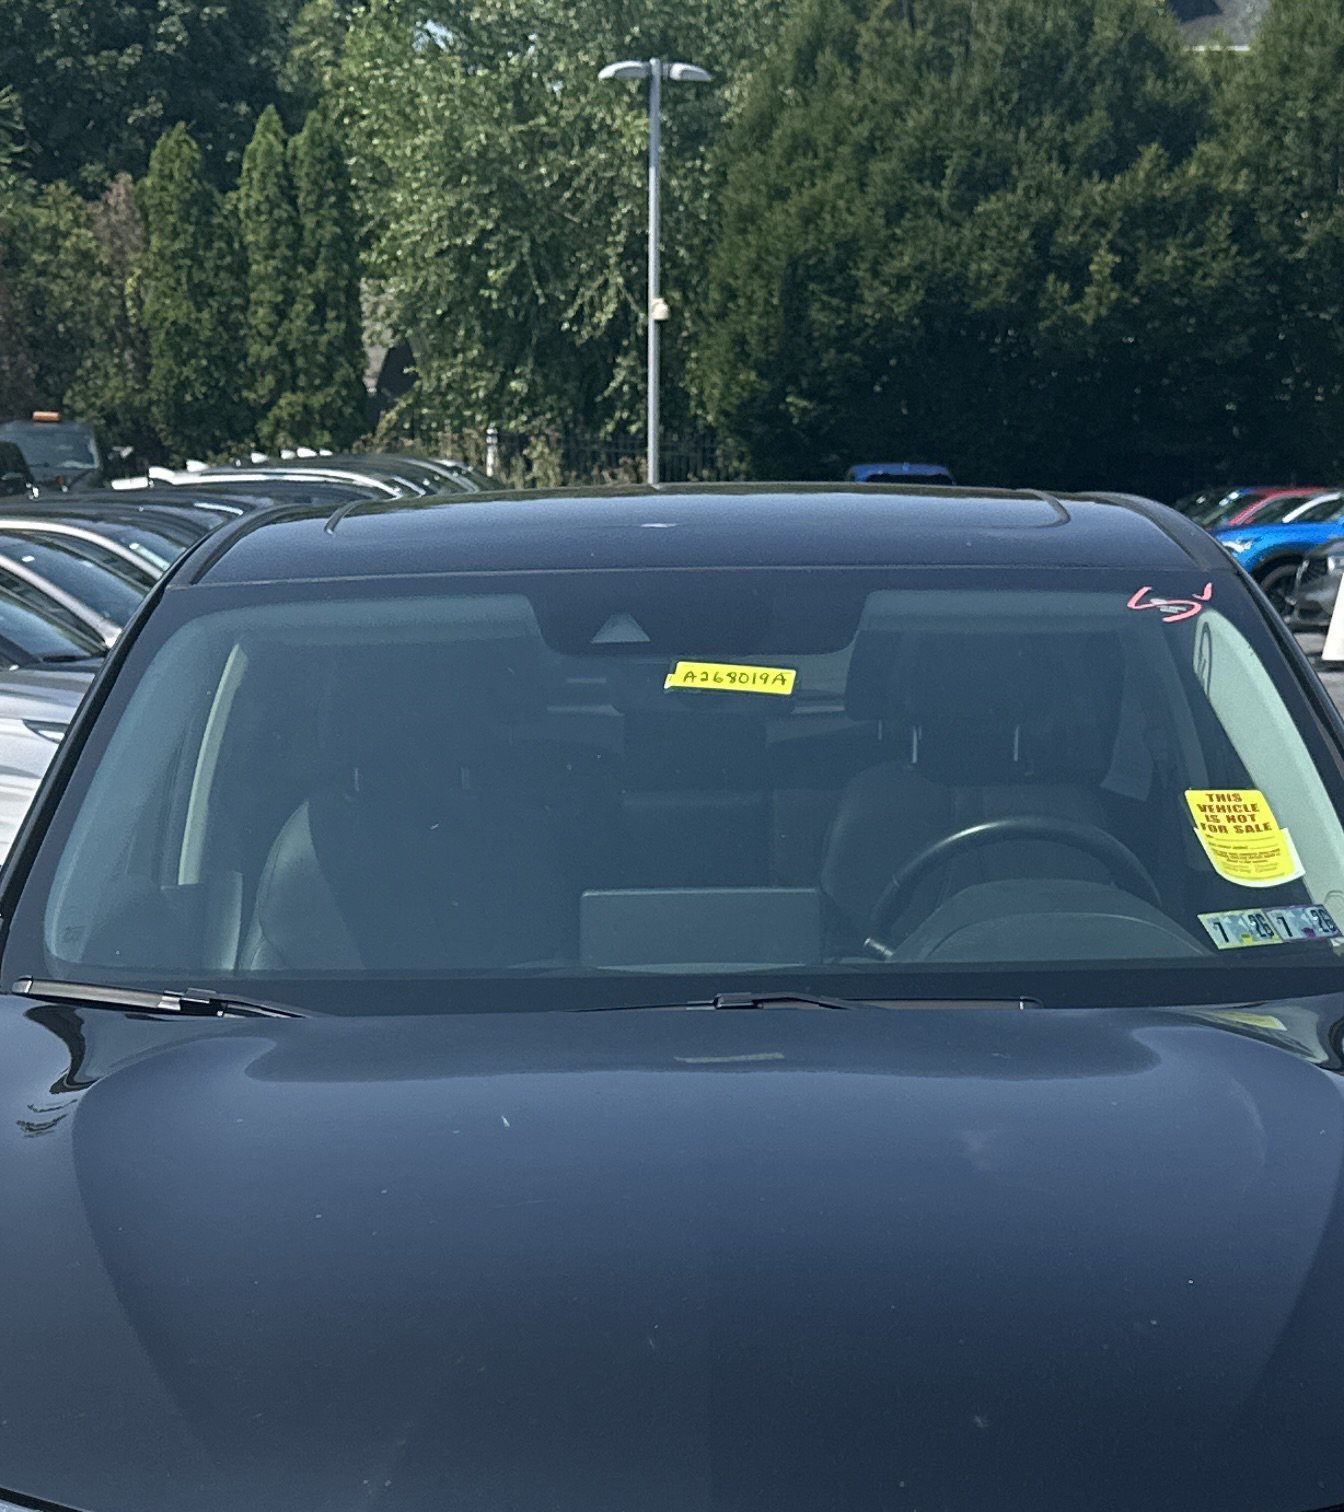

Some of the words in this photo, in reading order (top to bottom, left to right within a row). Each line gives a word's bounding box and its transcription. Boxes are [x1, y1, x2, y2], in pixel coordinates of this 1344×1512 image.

[683, 671, 787, 686] A268019A
[1205, 793, 1243, 802] THIS
[1196, 803, 1260, 813] VEHICLE
[1204, 814, 1221, 823] IS
[1225, 814, 1256, 823] NOT
[1200, 822, 1229, 834] FOR
[1233, 822, 1273, 834] SALE
[1213, 922, 1229, 943] 7
[1247, 913, 1275, 938] 26
[1277, 916, 1293, 937] 7
